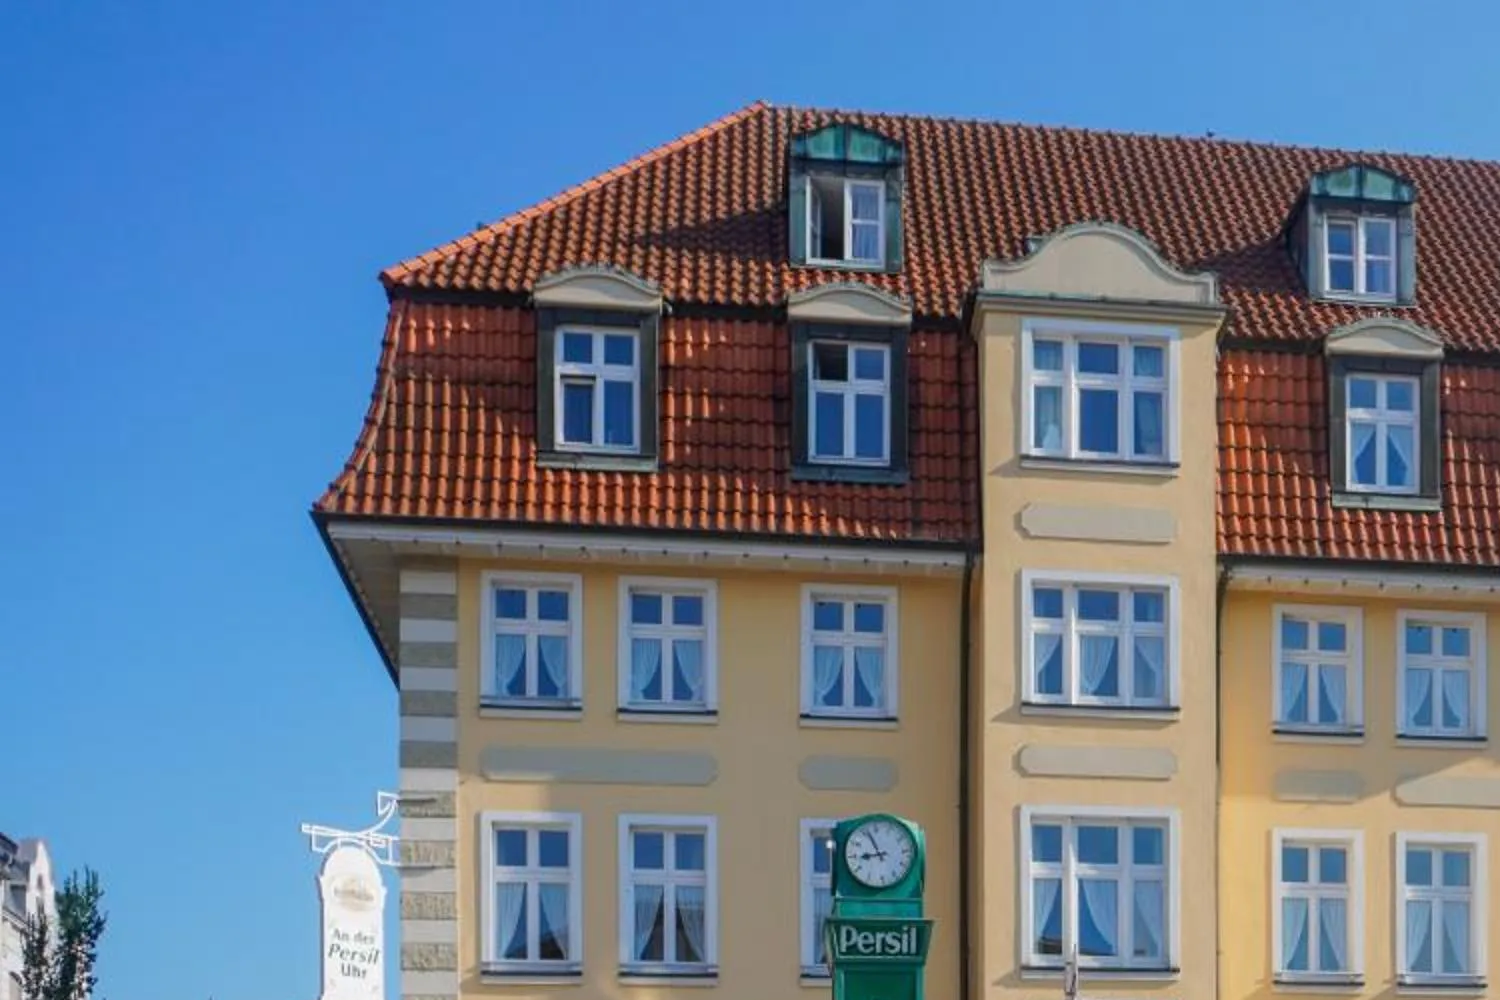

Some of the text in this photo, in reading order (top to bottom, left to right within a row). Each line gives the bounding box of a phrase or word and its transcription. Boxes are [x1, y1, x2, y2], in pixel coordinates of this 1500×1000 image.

[332, 927, 350, 942] An
[840, 925, 917, 954] Persil
[328, 943, 380, 965] Persil
[340, 962, 368, 979] Uhr
